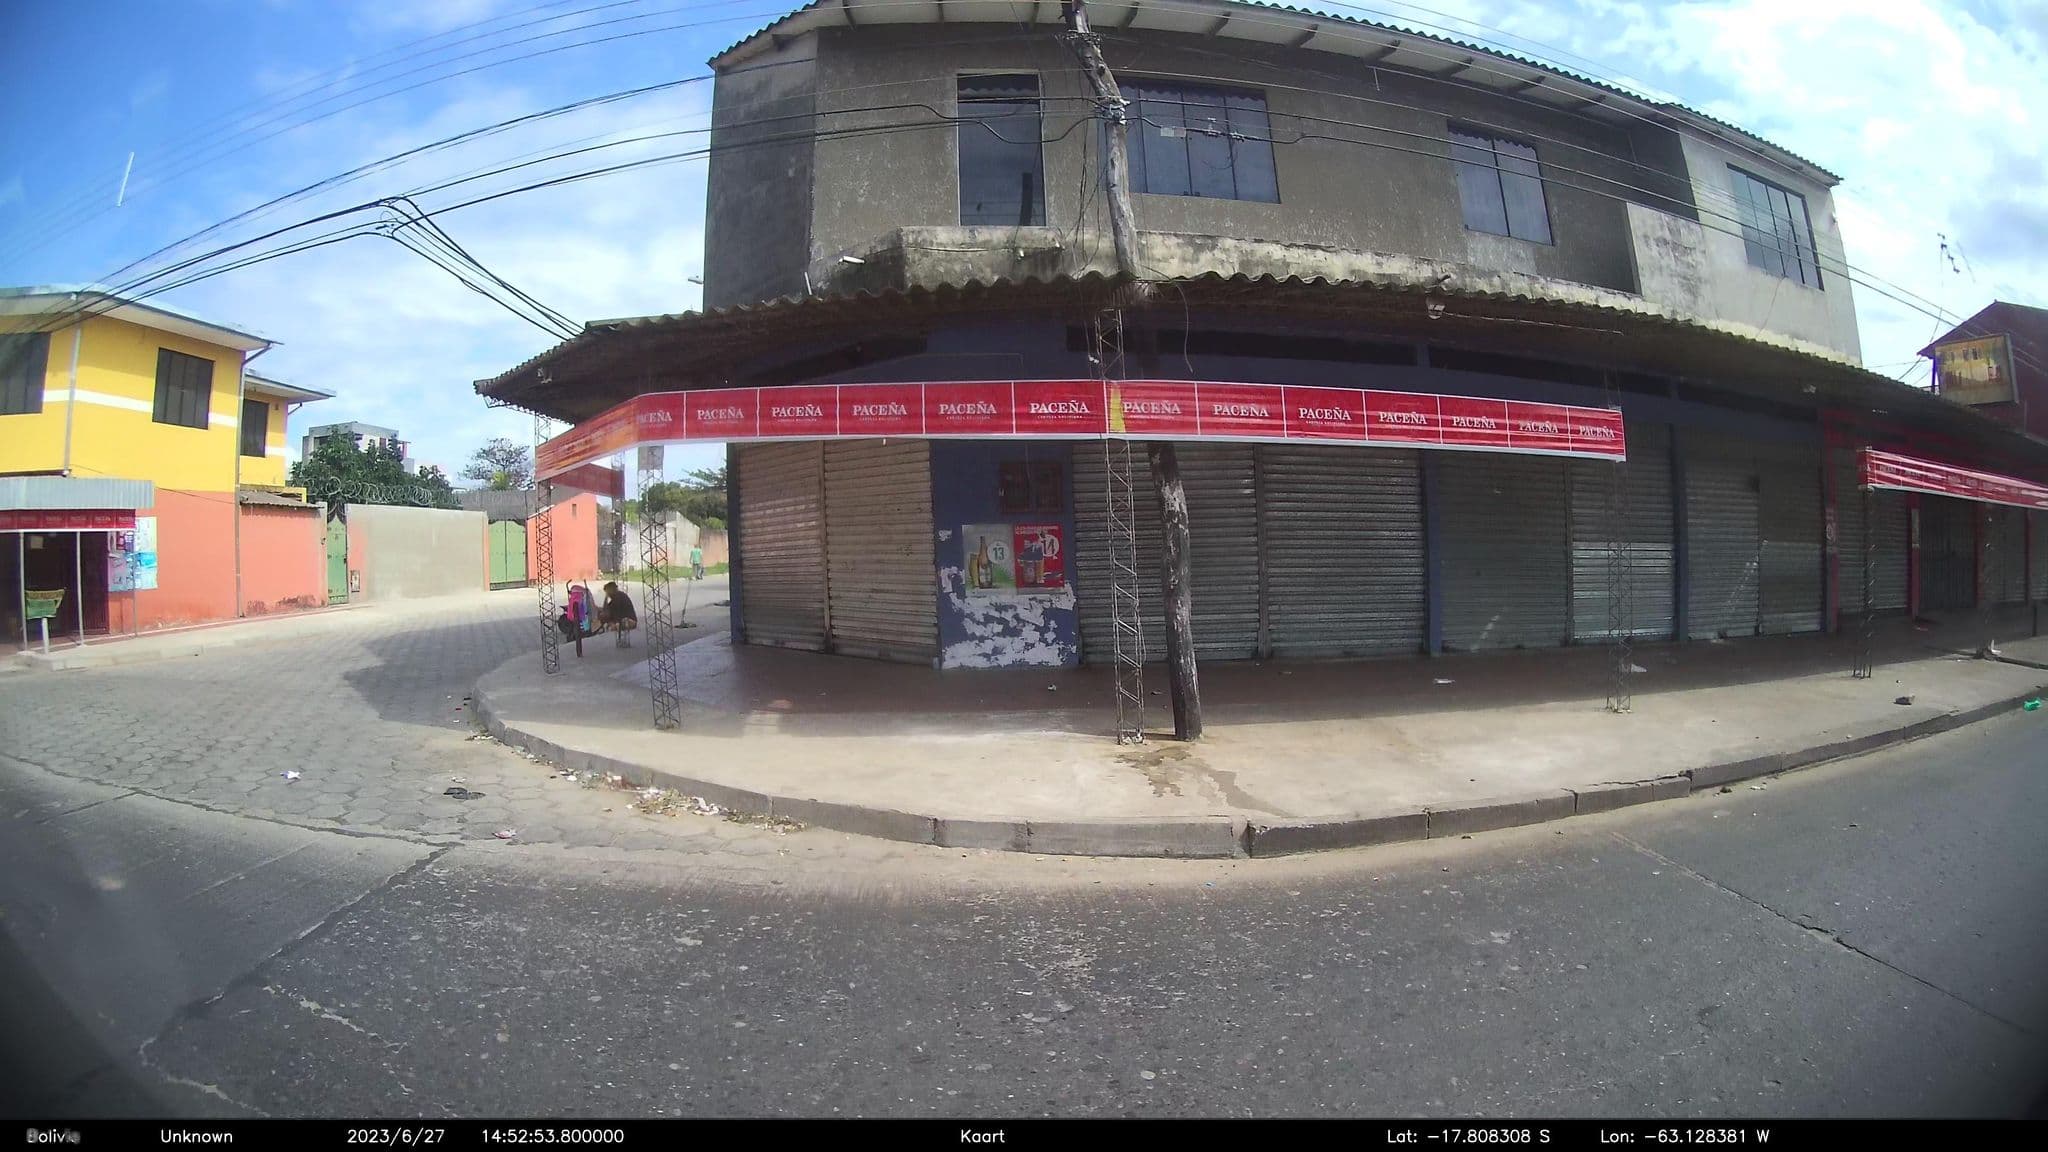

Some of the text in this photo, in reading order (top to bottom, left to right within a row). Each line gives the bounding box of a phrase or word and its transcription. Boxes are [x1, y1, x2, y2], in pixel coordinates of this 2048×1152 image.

[696, 406, 744, 421] PACEÑA
[771, 403, 823, 418] PACEÑA
[853, 401, 907, 416] PACEÑA
[938, 400, 997, 415] PACEÑA
[1029, 399, 1090, 414] PACEÑA
[1122, 399, 1181, 414] PACEÑA
[1213, 403, 1269, 417] PACEÑA
[1298, 406, 1352, 421] PACEÑA
[1379, 411, 1428, 425] PACEÑA
[1451, 415, 1497, 430] PACEÑA
[1519, 420, 1559, 434] PACEÑA
[992, 547, 1004, 561] 13
[1041, 538, 1055, 555] 14
